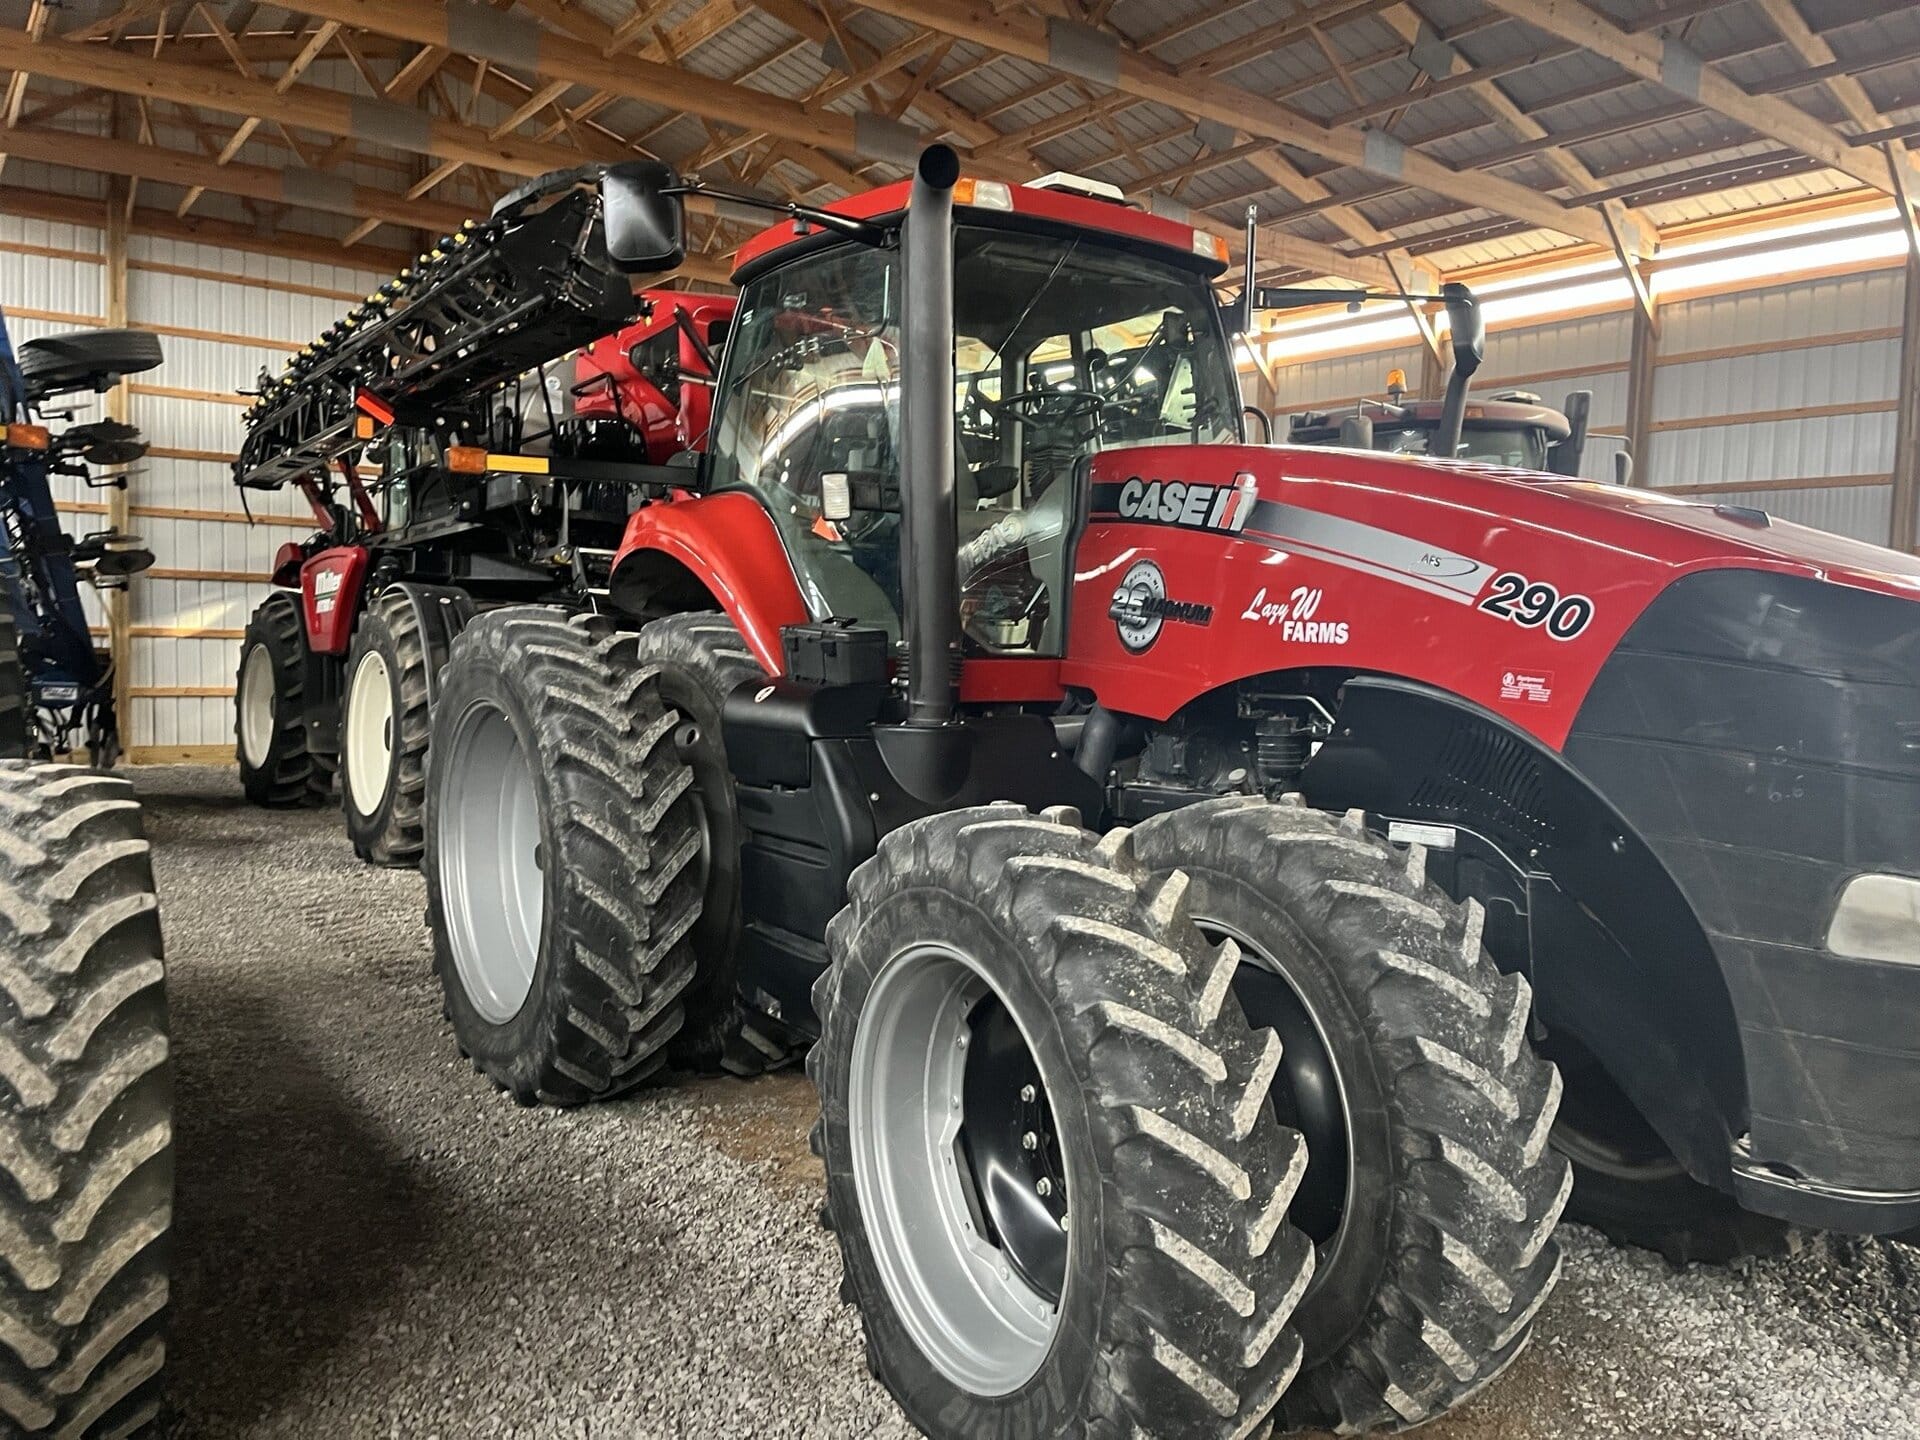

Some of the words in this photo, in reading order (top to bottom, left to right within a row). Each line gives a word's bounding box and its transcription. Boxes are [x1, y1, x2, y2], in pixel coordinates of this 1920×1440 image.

[1118, 478, 1214, 526] CASE
[1420, 553, 1442, 568] AFS
[1108, 586, 1147, 619] 25
[1240, 587, 1290, 626] Lazy
[1290, 586, 1323, 621] W
[1477, 571, 1596, 642] 290
[1282, 620, 1350, 645] FARMS
